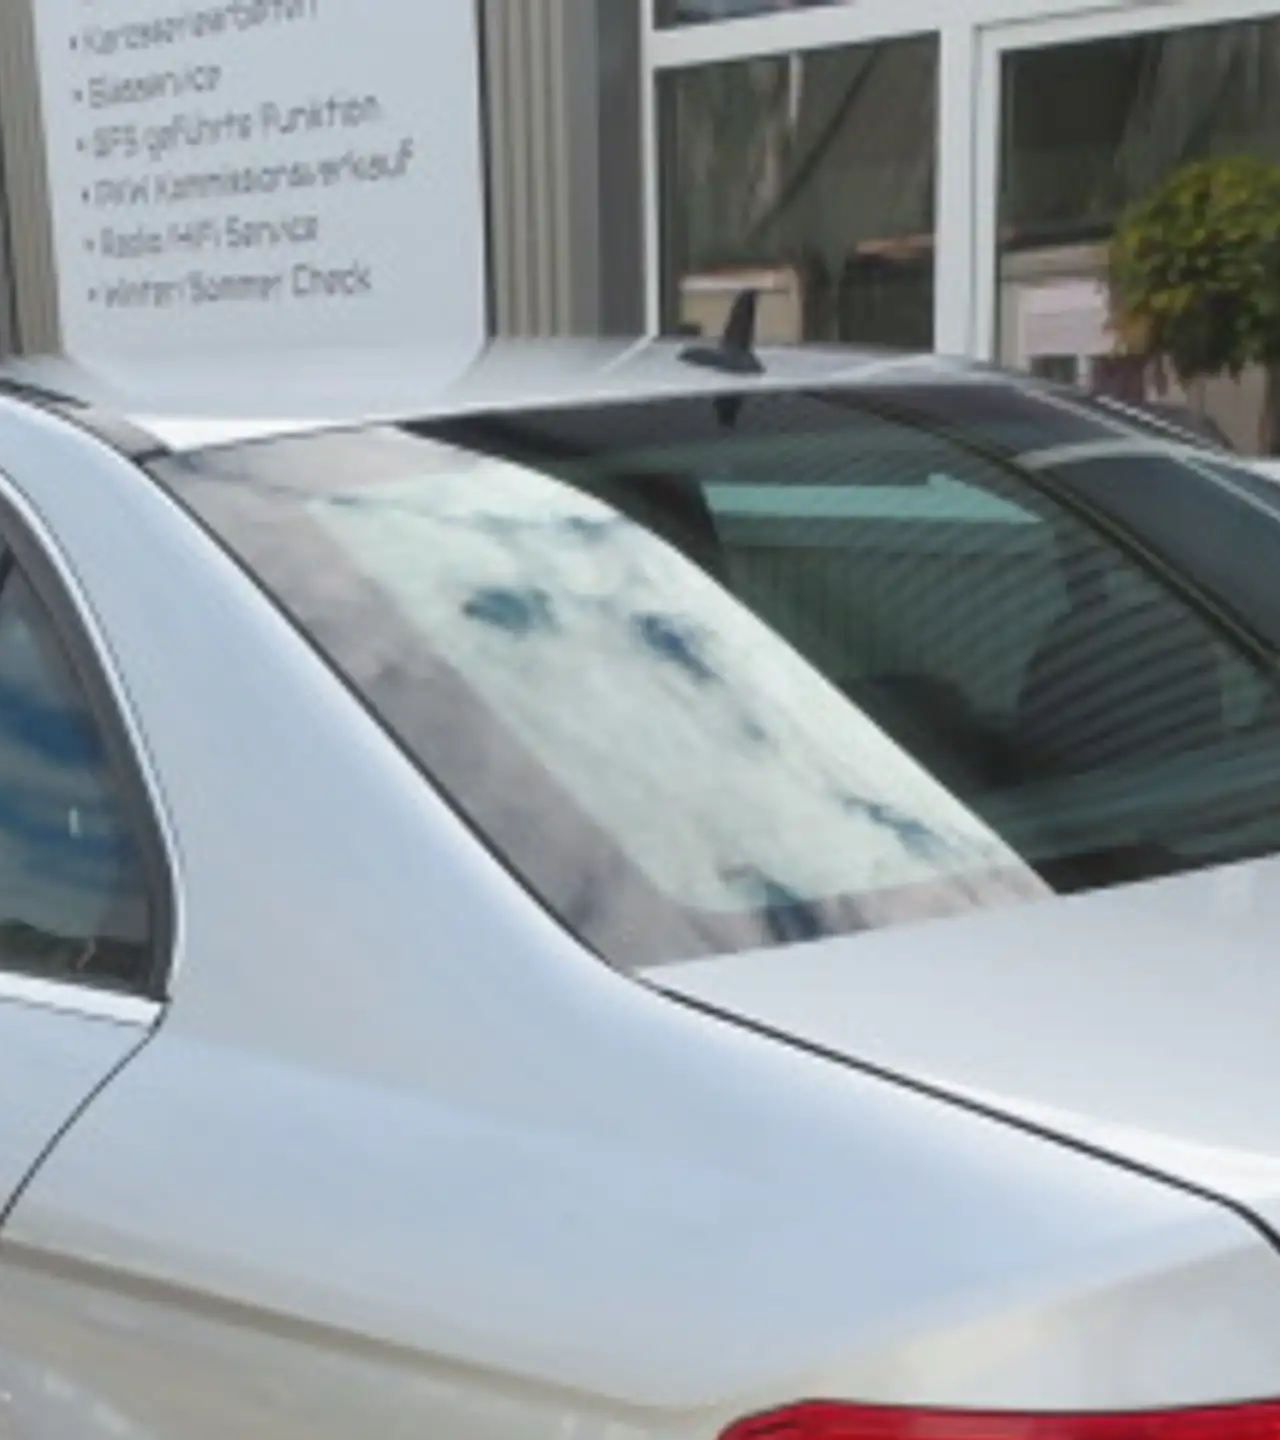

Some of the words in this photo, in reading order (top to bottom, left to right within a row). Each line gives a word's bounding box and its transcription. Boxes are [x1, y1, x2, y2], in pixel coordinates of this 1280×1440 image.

[260, 94, 381, 136] Funktion
[225, 214, 319, 249] Service
[291, 259, 374, 298] Check
